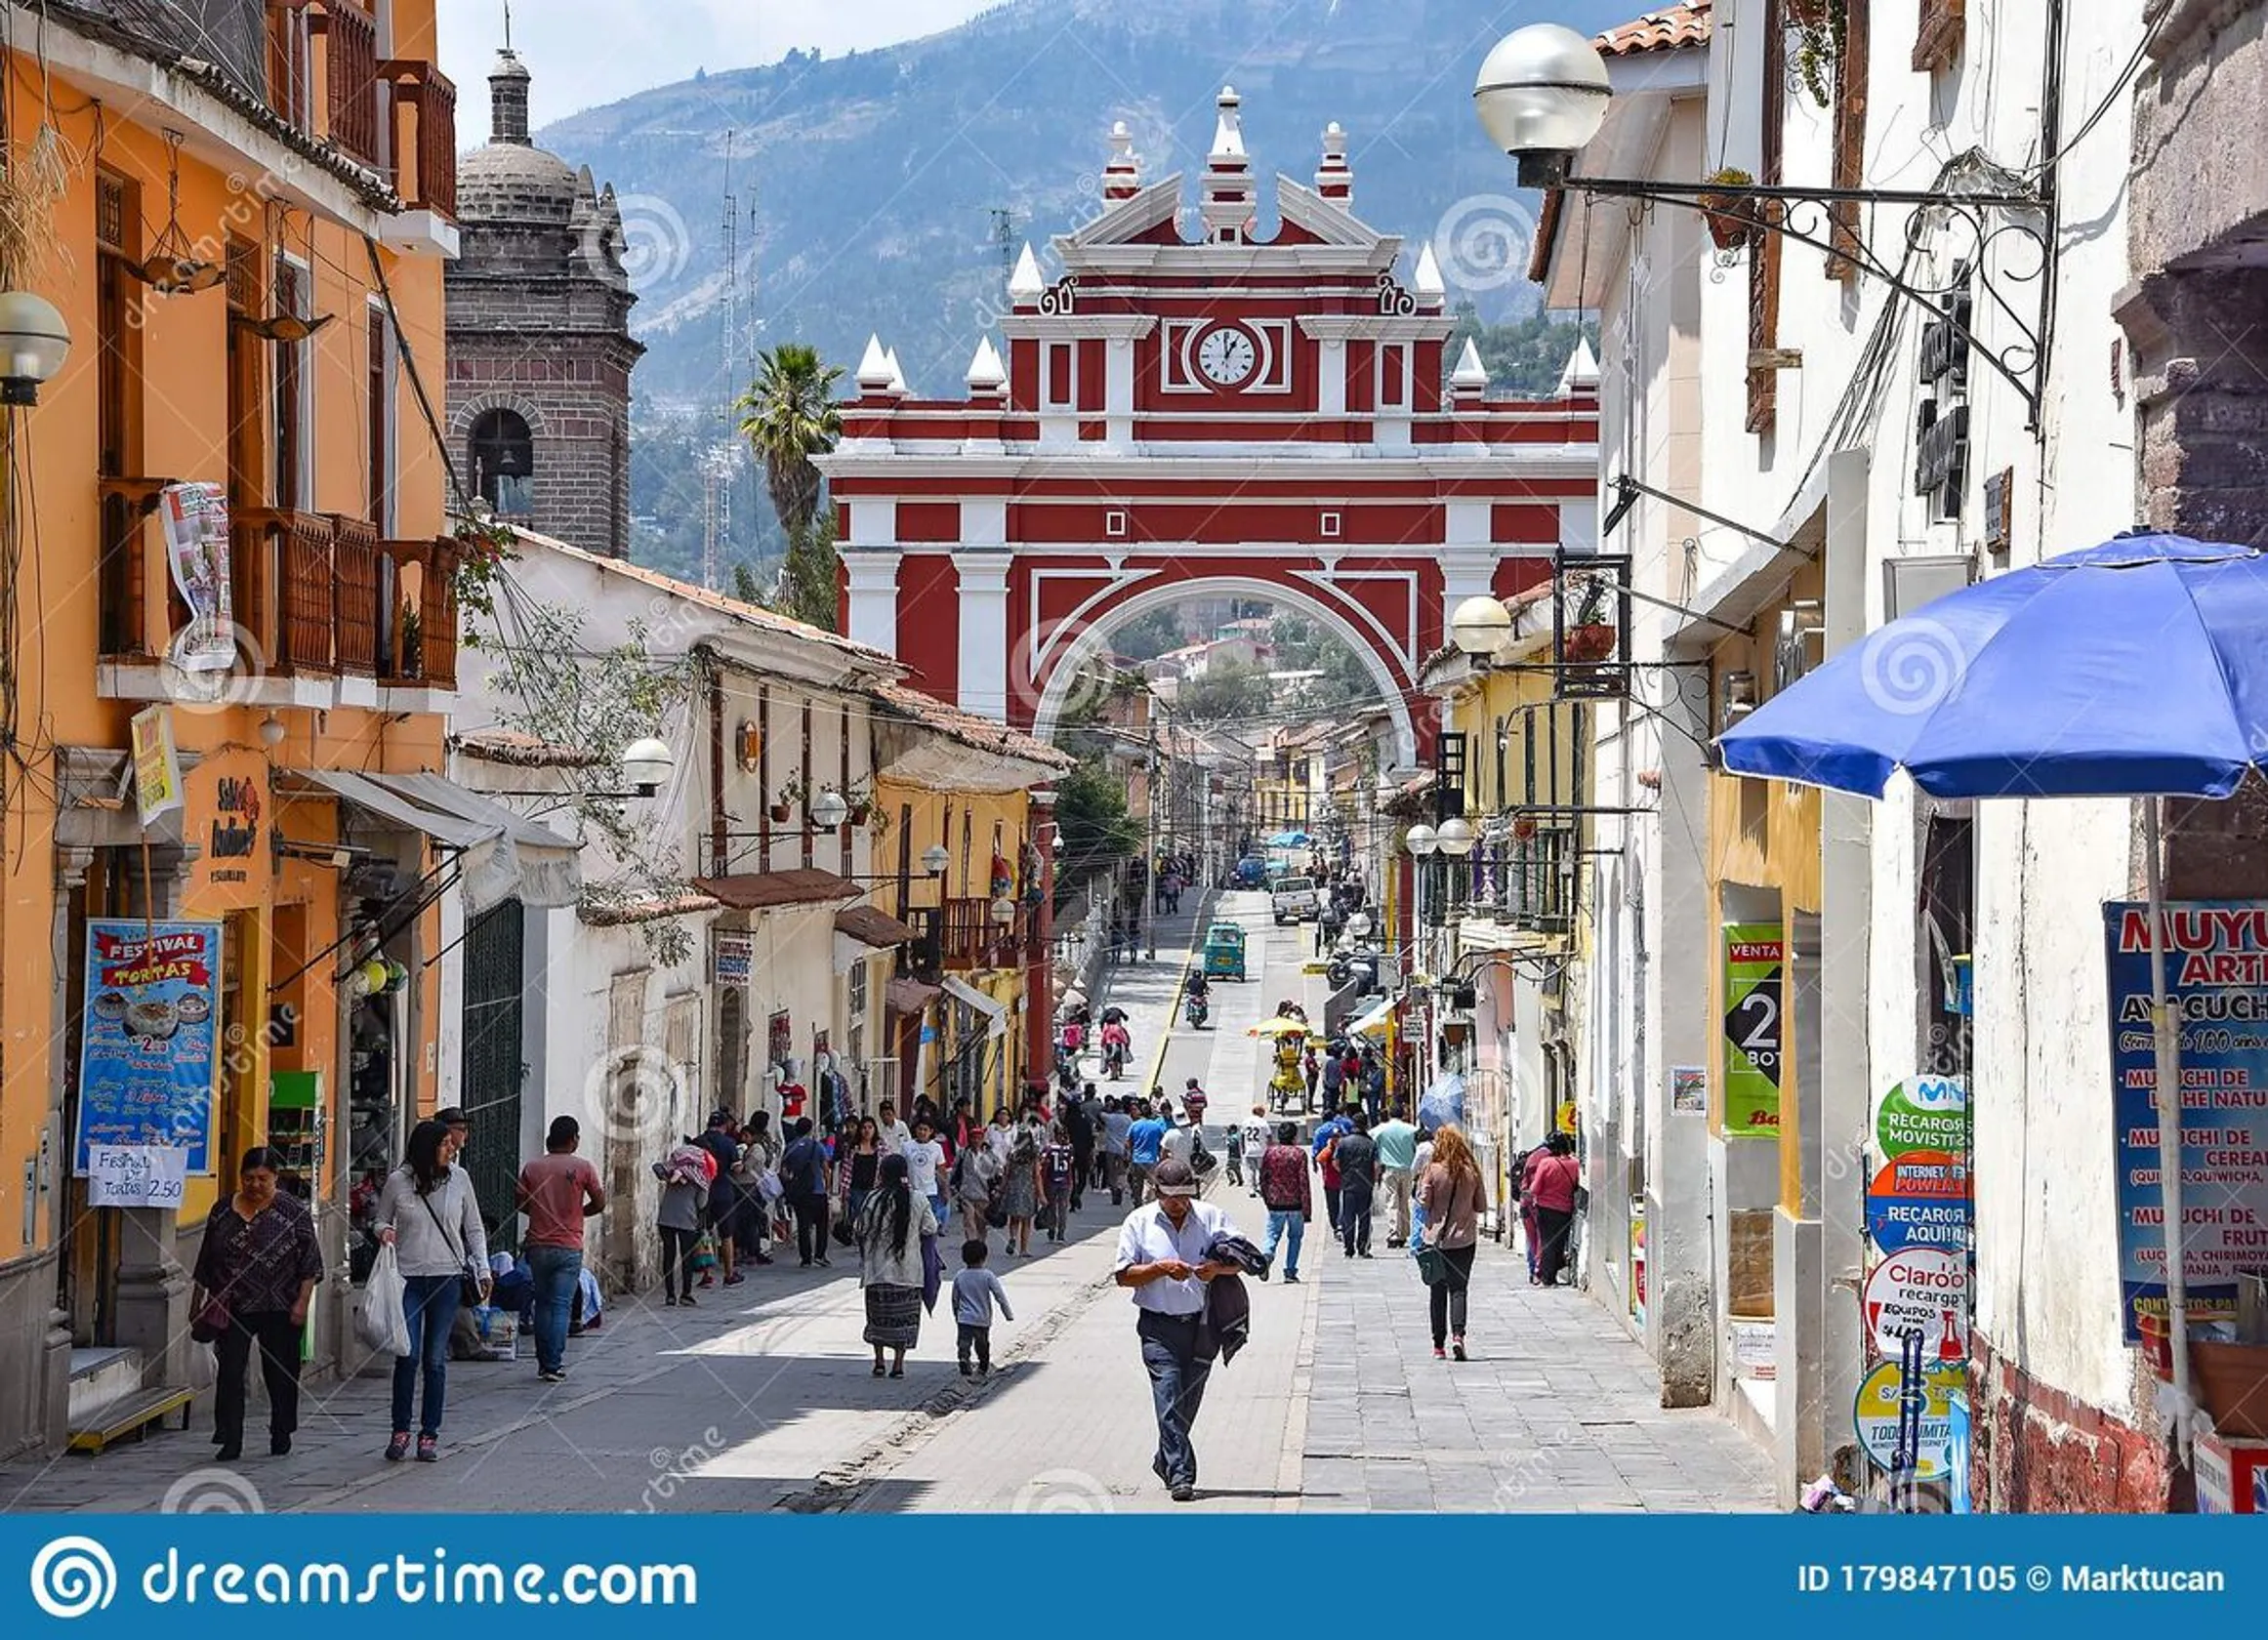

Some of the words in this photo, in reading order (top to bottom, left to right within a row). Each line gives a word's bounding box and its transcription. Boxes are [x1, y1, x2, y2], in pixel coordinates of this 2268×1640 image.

[1731, 944, 1780, 957] VENTA
[2178, 952, 2268, 986] ART
[1741, 993, 1778, 1047] 2
[2195, 1028, 2231, 1053] 100
[2125, 1069, 2217, 1088] MUCHI
[2221, 1068, 2248, 1086] DE
[2226, 1128, 2251, 1146] DE
[2206, 1149, 2268, 1168] CEREA
[147, 1179, 183, 1199] 2.50
[2231, 1208, 2256, 1225] DE
[1883, 1302, 1936, 1320] EQUIPOS
